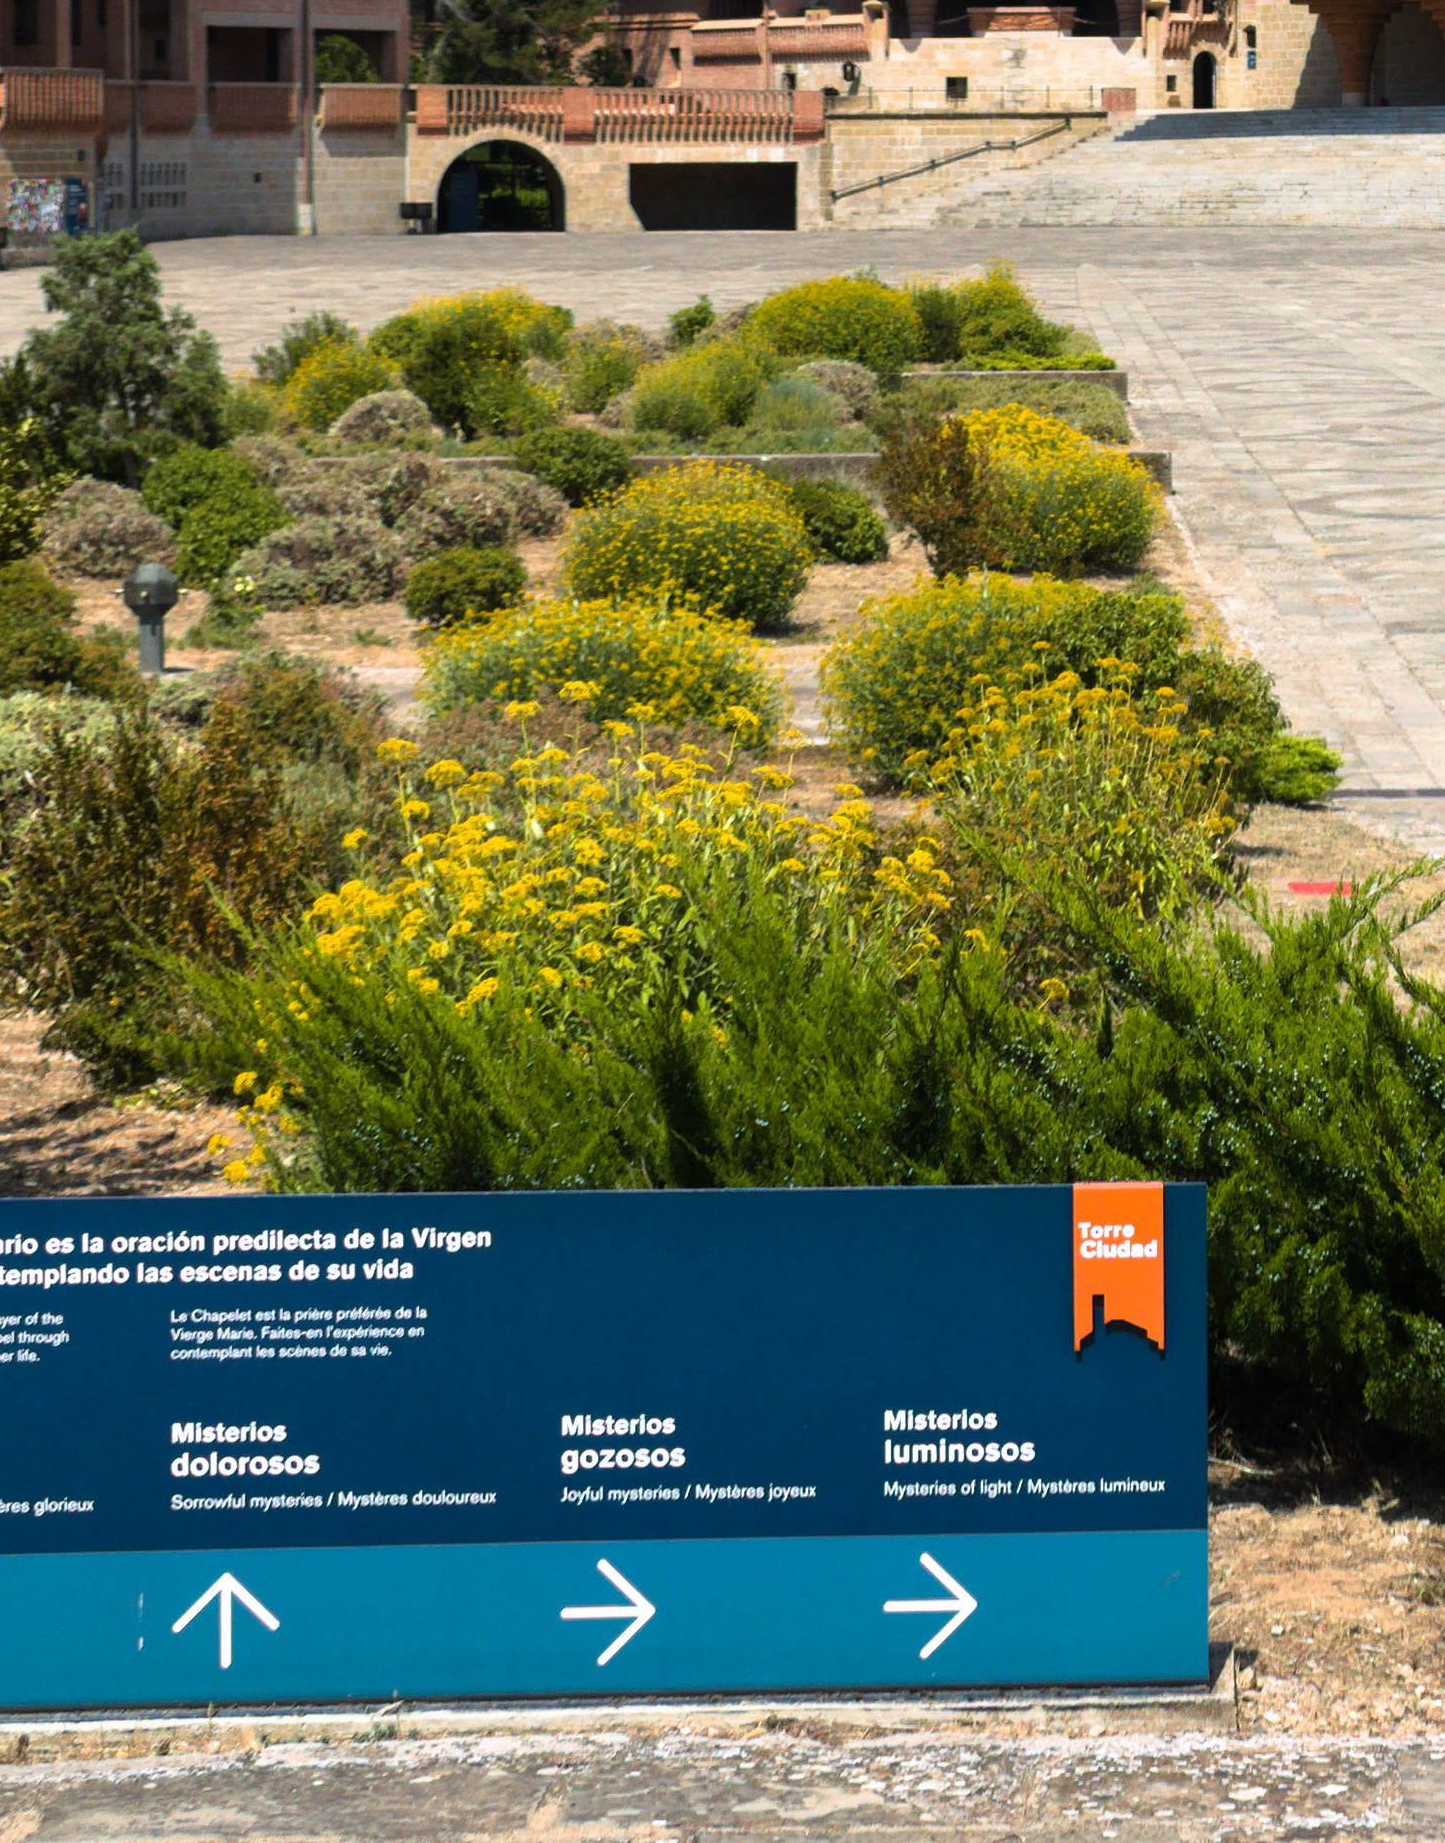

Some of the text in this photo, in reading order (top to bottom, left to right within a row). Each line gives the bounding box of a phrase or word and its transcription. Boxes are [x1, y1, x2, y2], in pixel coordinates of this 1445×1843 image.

[44, 1236, 76, 1255] es
[81, 1232, 105, 1254] la
[110, 1230, 206, 1254] oración
[212, 1229, 337, 1256] predilecta
[343, 1227, 376, 1250] de
[381, 1227, 405, 1249] la
[410, 1227, 492, 1253] Virgen
[1077, 1221, 1136, 1239] Torre
[1079, 1239, 1159, 1259] Ciudad
[135, 1262, 174, 1284] las
[178, 1264, 283, 1283] escenas
[287, 1259, 321, 1282] de
[325, 1263, 356, 1281] su
[362, 1257, 414, 1280] vida
[24, 1311, 39, 1326] of
[41, 1312, 64, 1325] the
[170, 1305, 428, 1325] Le Chapelet est la prière préférée de la
[17, 1330, 70, 1347] through
[170, 1324, 425, 1345] Vierge Marie. Faites-en l'expérience en
[16, 1348, 41, 1363] life.
[170, 1342, 392, 1362] contemplant les scènes de sa vie.
[561, 1413, 676, 1437] Misterios
[883, 1408, 998, 1431] Misterios
[170, 1421, 288, 1445] Misterios
[560, 1447, 686, 1475] gozosos
[884, 1438, 1036, 1465] luminosos
[170, 1451, 321, 1478] dolorosos
[560, 1486, 604, 1506] Joyful
[607, 1485, 681, 1505] mysteries
[695, 1483, 765, 1503] Mystères
[768, 1482, 816, 1502] joyeux
[883, 1480, 957, 1501] Mysteries
[960, 1479, 977, 1496] of
[979, 1479, 1013, 1499] light
[1026, 1478, 1096, 1498] Mystères
[1099, 1476, 1166, 1493] lumineux
[33, 1496, 95, 1517] glorieux
[170, 1493, 246, 1511] Sorrowful
[249, 1492, 323, 1512] mysteries
[337, 1491, 408, 1511] Mystères
[411, 1489, 497, 1506] douloureux
